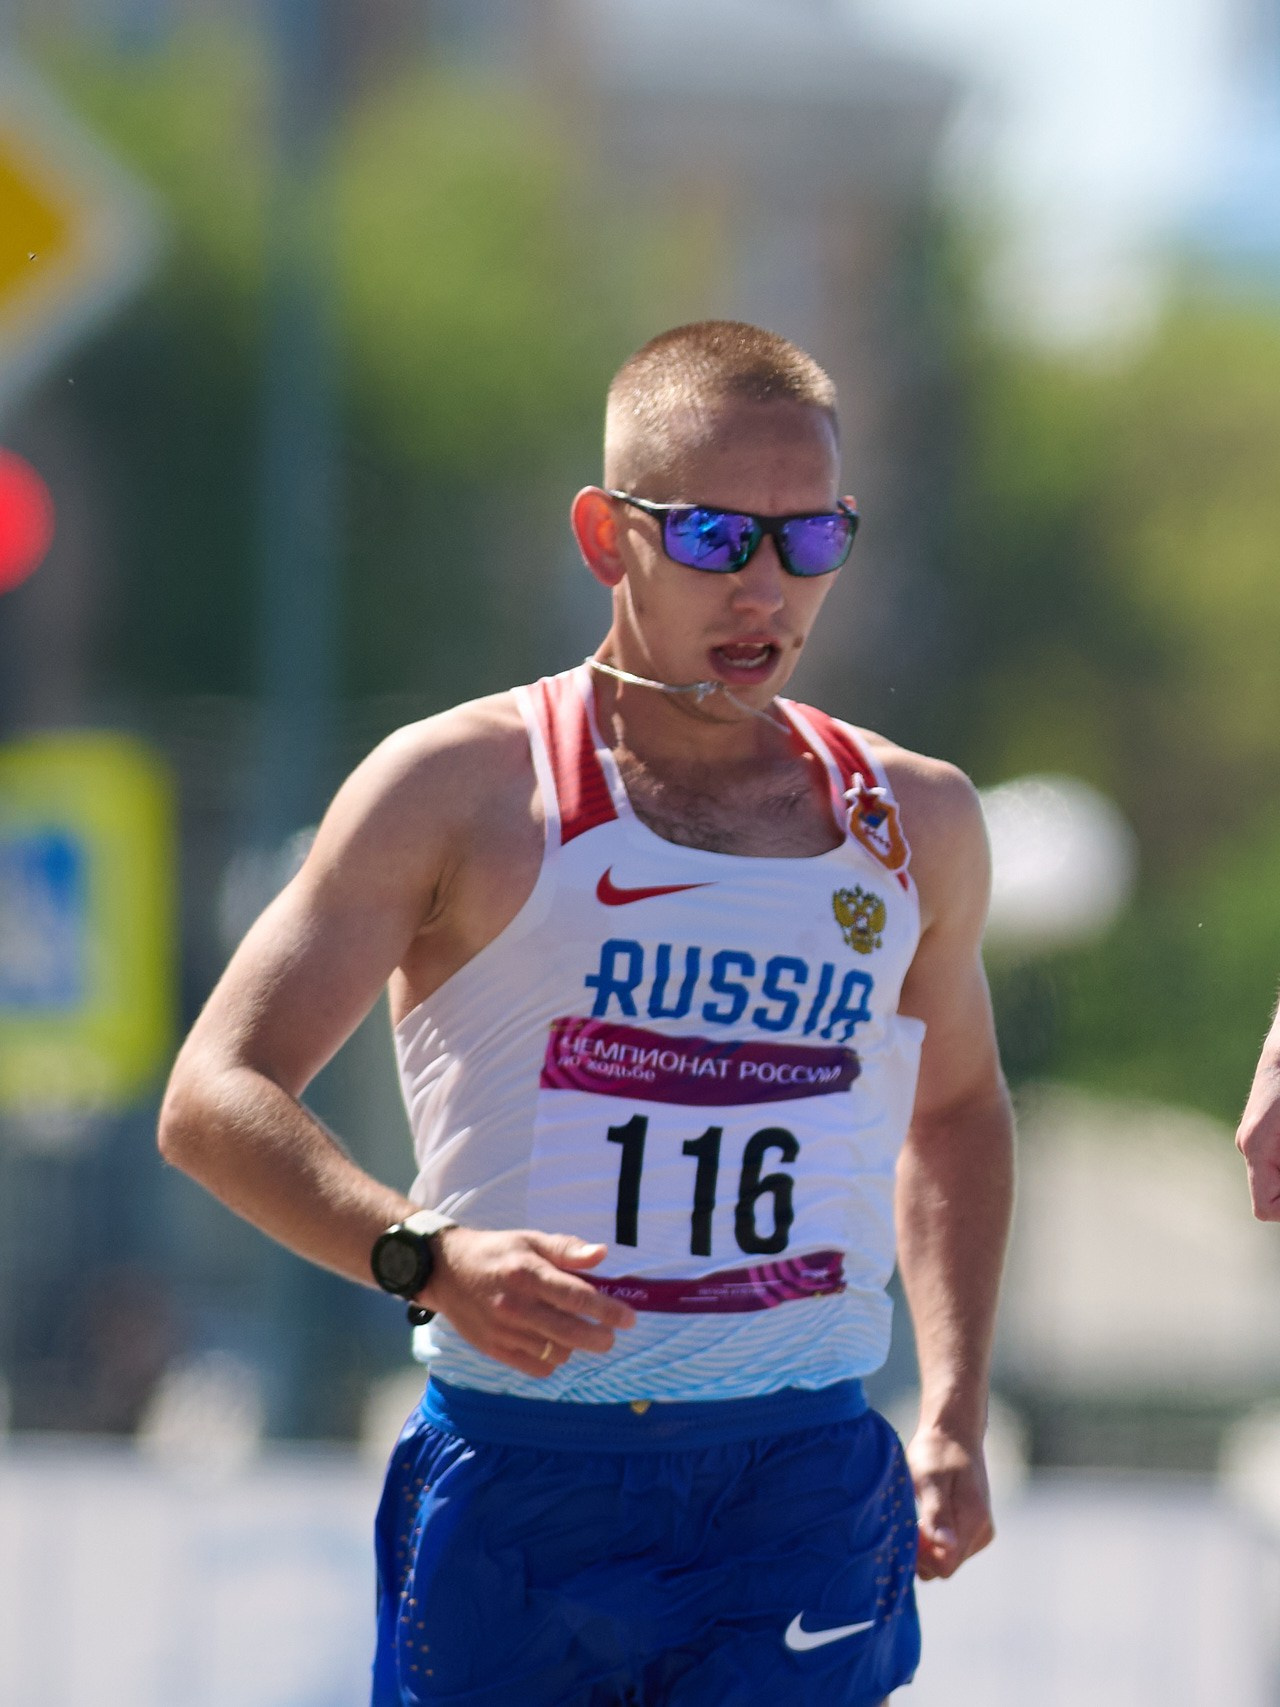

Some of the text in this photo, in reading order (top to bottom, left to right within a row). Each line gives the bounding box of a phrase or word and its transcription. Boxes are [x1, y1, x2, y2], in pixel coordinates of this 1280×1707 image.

[585, 938, 873, 1042] RUSSIA
[560, 1035, 842, 1084] ЧЕМПИОНАТ РОССИИ
[607, 1113, 800, 1257] 116
